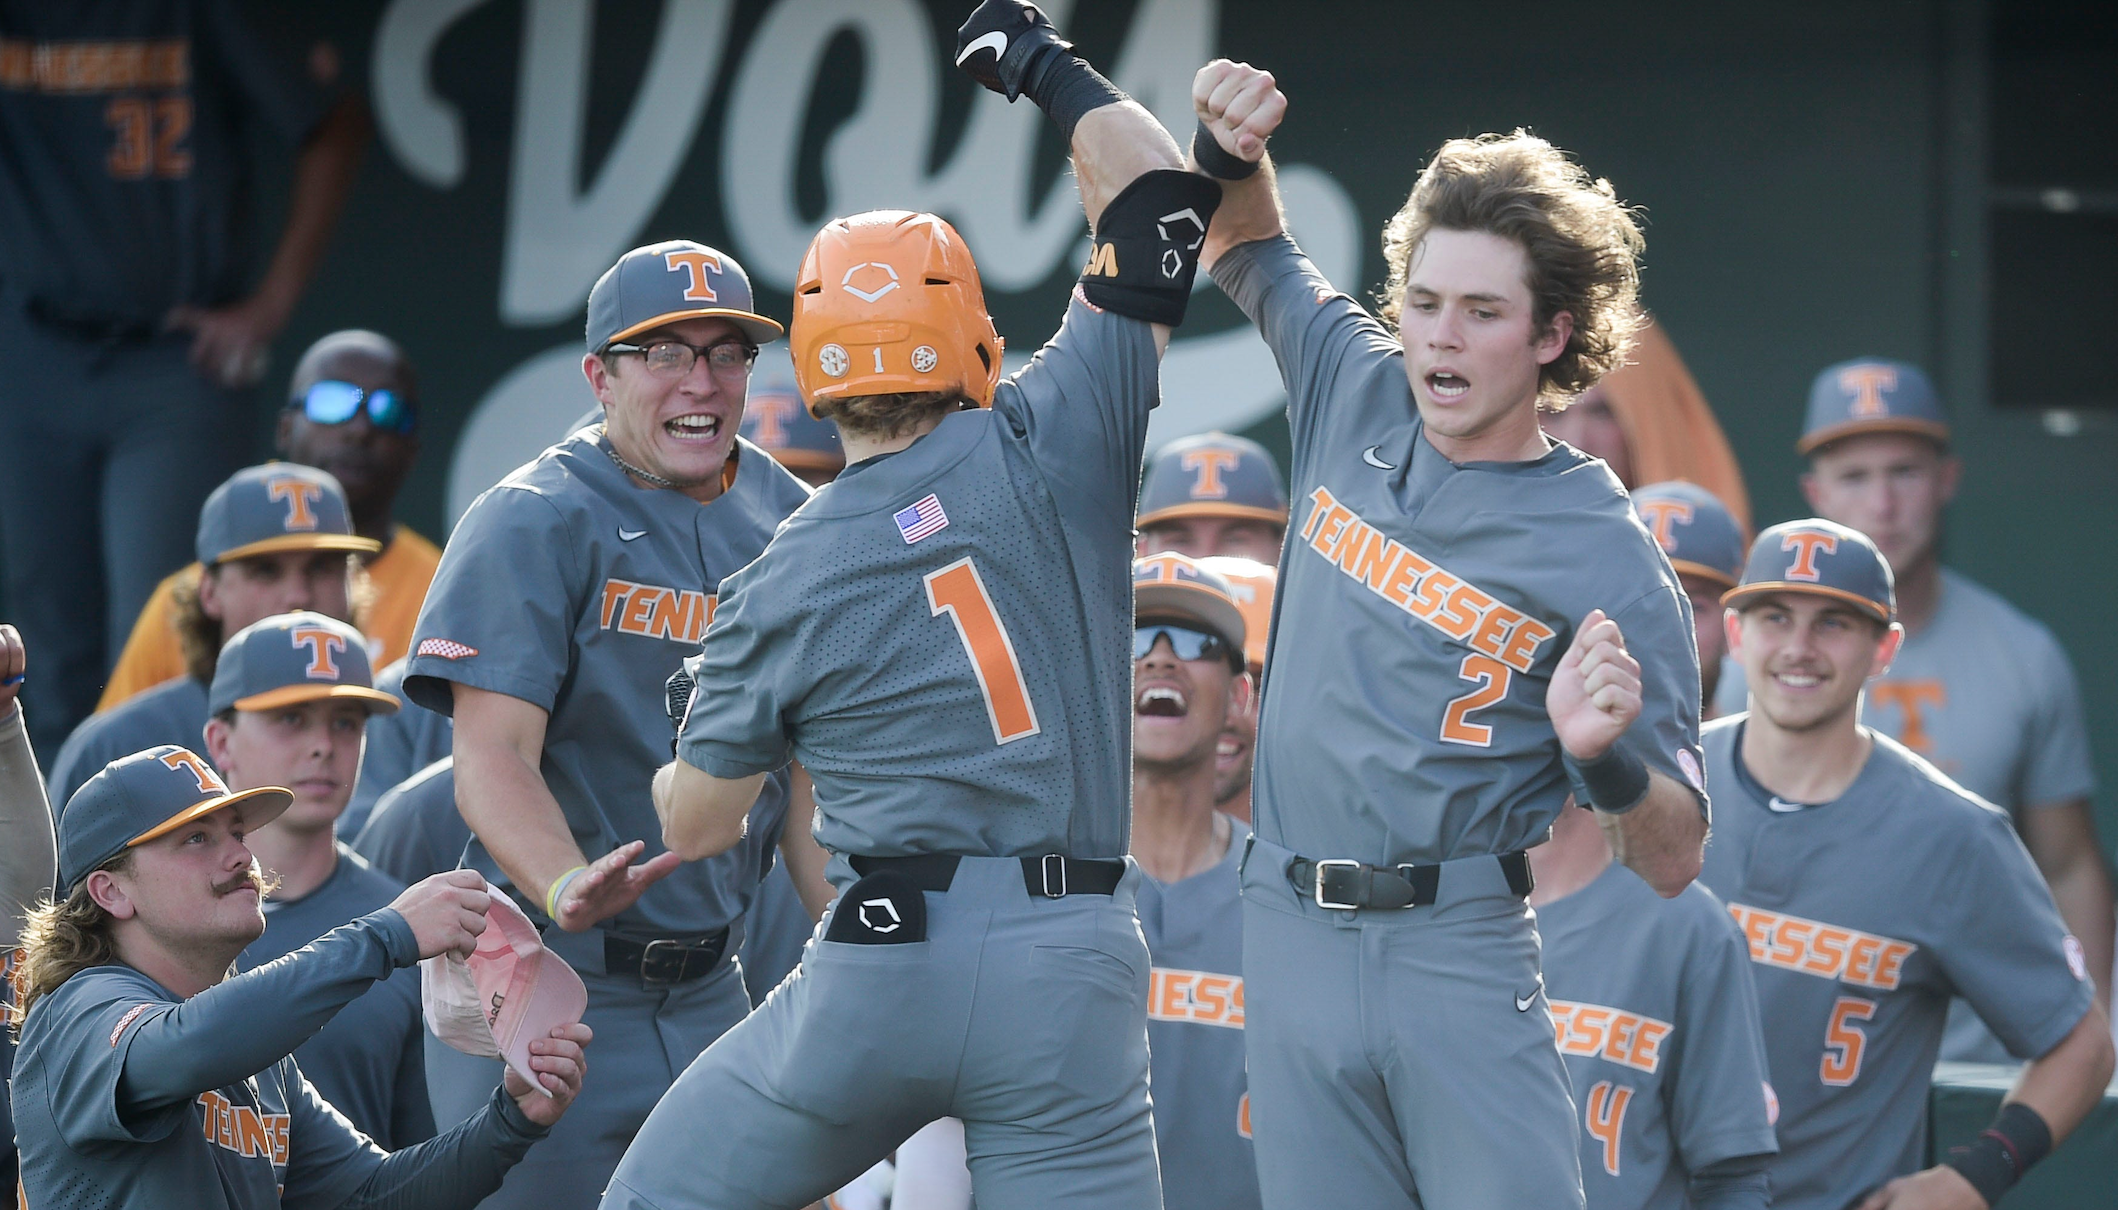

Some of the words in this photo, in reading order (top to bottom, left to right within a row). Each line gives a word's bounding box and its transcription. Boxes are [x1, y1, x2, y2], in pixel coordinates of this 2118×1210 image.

[664, 250, 723, 303] T
[873, 347, 884, 373] 1
[1841, 365, 1895, 418] T
[1181, 446, 1239, 499] T
[267, 477, 323, 531] T
[1637, 497, 1694, 555] T
[1301, 485, 1557, 674] TENNESSEE
[1781, 531, 1838, 583] T
[291, 627, 347, 680] T
[923, 556, 1041, 746] 1
[1439, 652, 1512, 747] 2
[1870, 680, 1947, 756] T
[160, 749, 225, 793] T
[1727, 902, 1918, 990] ESSEE
[1819, 996, 1879, 1087] 5
[1586, 1080, 1635, 1176] 4
